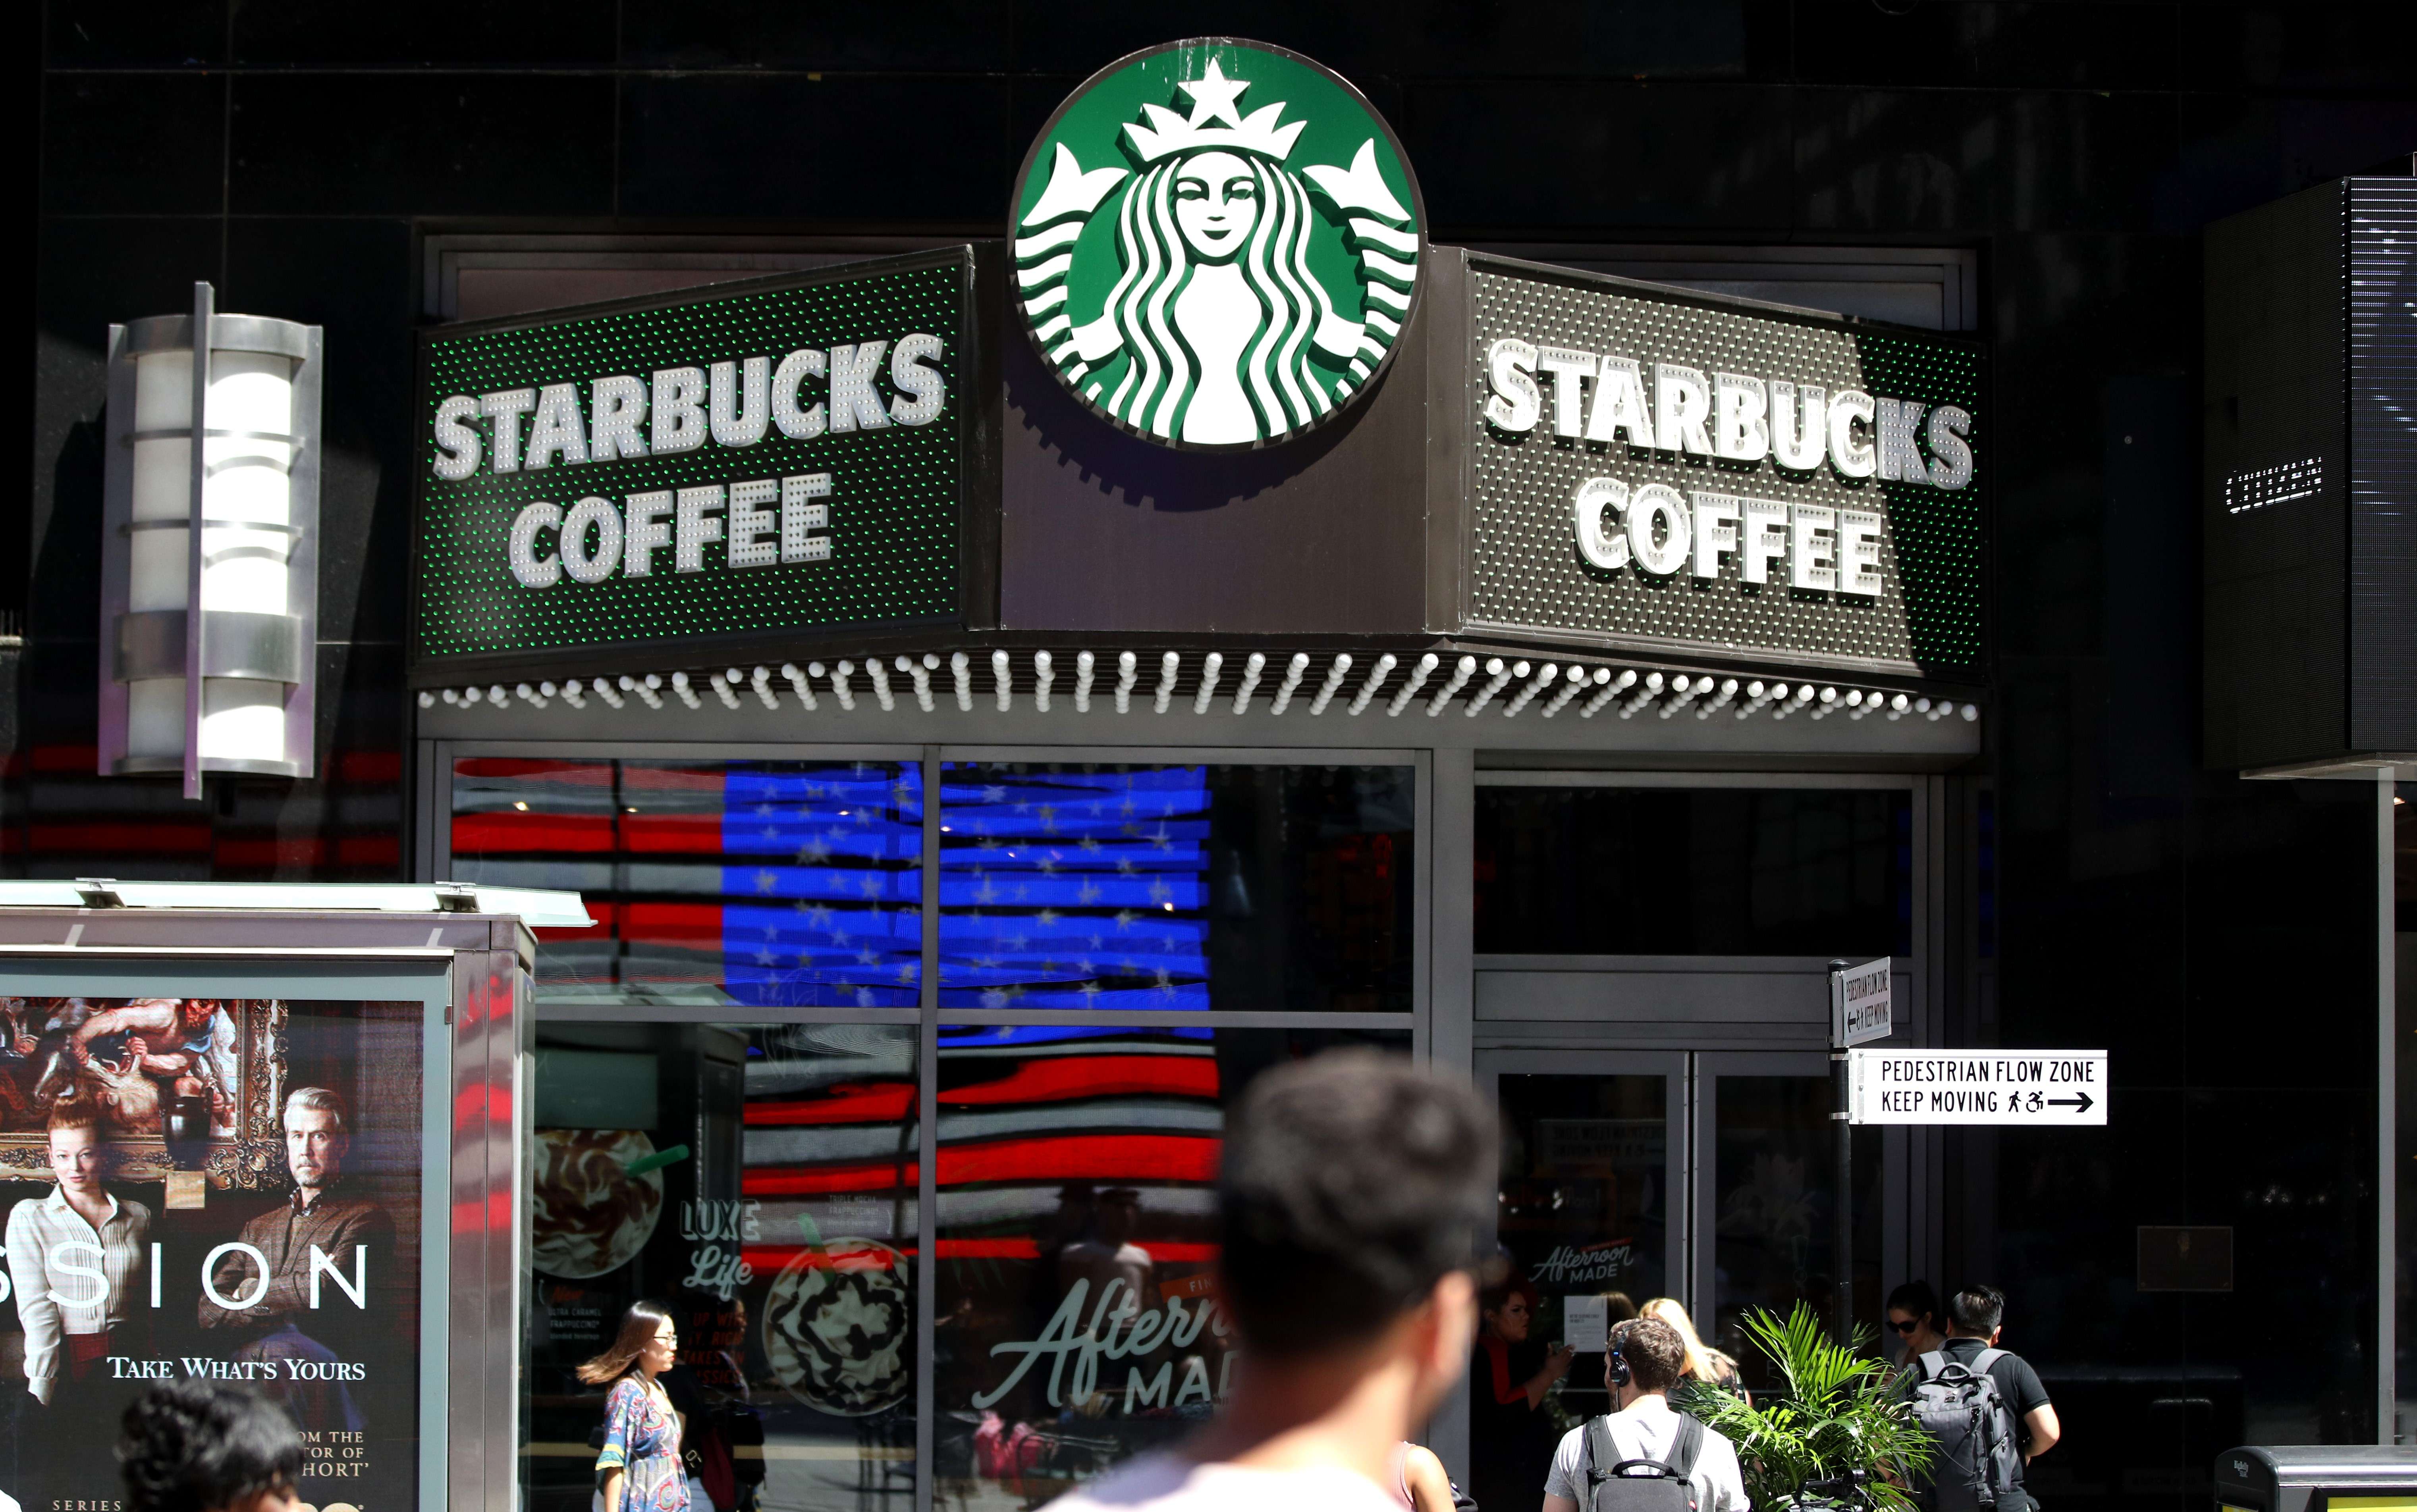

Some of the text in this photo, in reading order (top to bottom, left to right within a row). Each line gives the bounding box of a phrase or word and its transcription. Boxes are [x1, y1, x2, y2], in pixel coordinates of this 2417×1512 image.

[433, 333, 945, 482] STARBUCKS
[1485, 338, 1973, 490] STARBUCKS
[509, 473, 832, 589] COFFEE
[1575, 477, 1882, 597] COFFEE
[1846, 969, 1887, 1002] PEDESTRIAN FLOW ZONE
[1865, 1000, 1888, 1029] KEEP MOVING
[1882, 1061, 2094, 1082] PEDESTRIAN FLOW ZONE
[1882, 1091, 1998, 1113] KEEP MOVING
[679, 1199, 762, 1241] LUXE
[682, 1245, 754, 1302] Life
[1528, 1245, 1634, 1283] Afternoon
[1569, 1263, 1619, 1284] MADE
[571, 1308, 602, 1317] CARAMEL
[106, 1357, 174, 1379] TAKE
[283, 1359, 366, 1380] YOURS
[329, 1431, 364, 1443] THE
[342, 1447, 364, 1458] OF
[52, 1500, 121, 1511] SERIES
